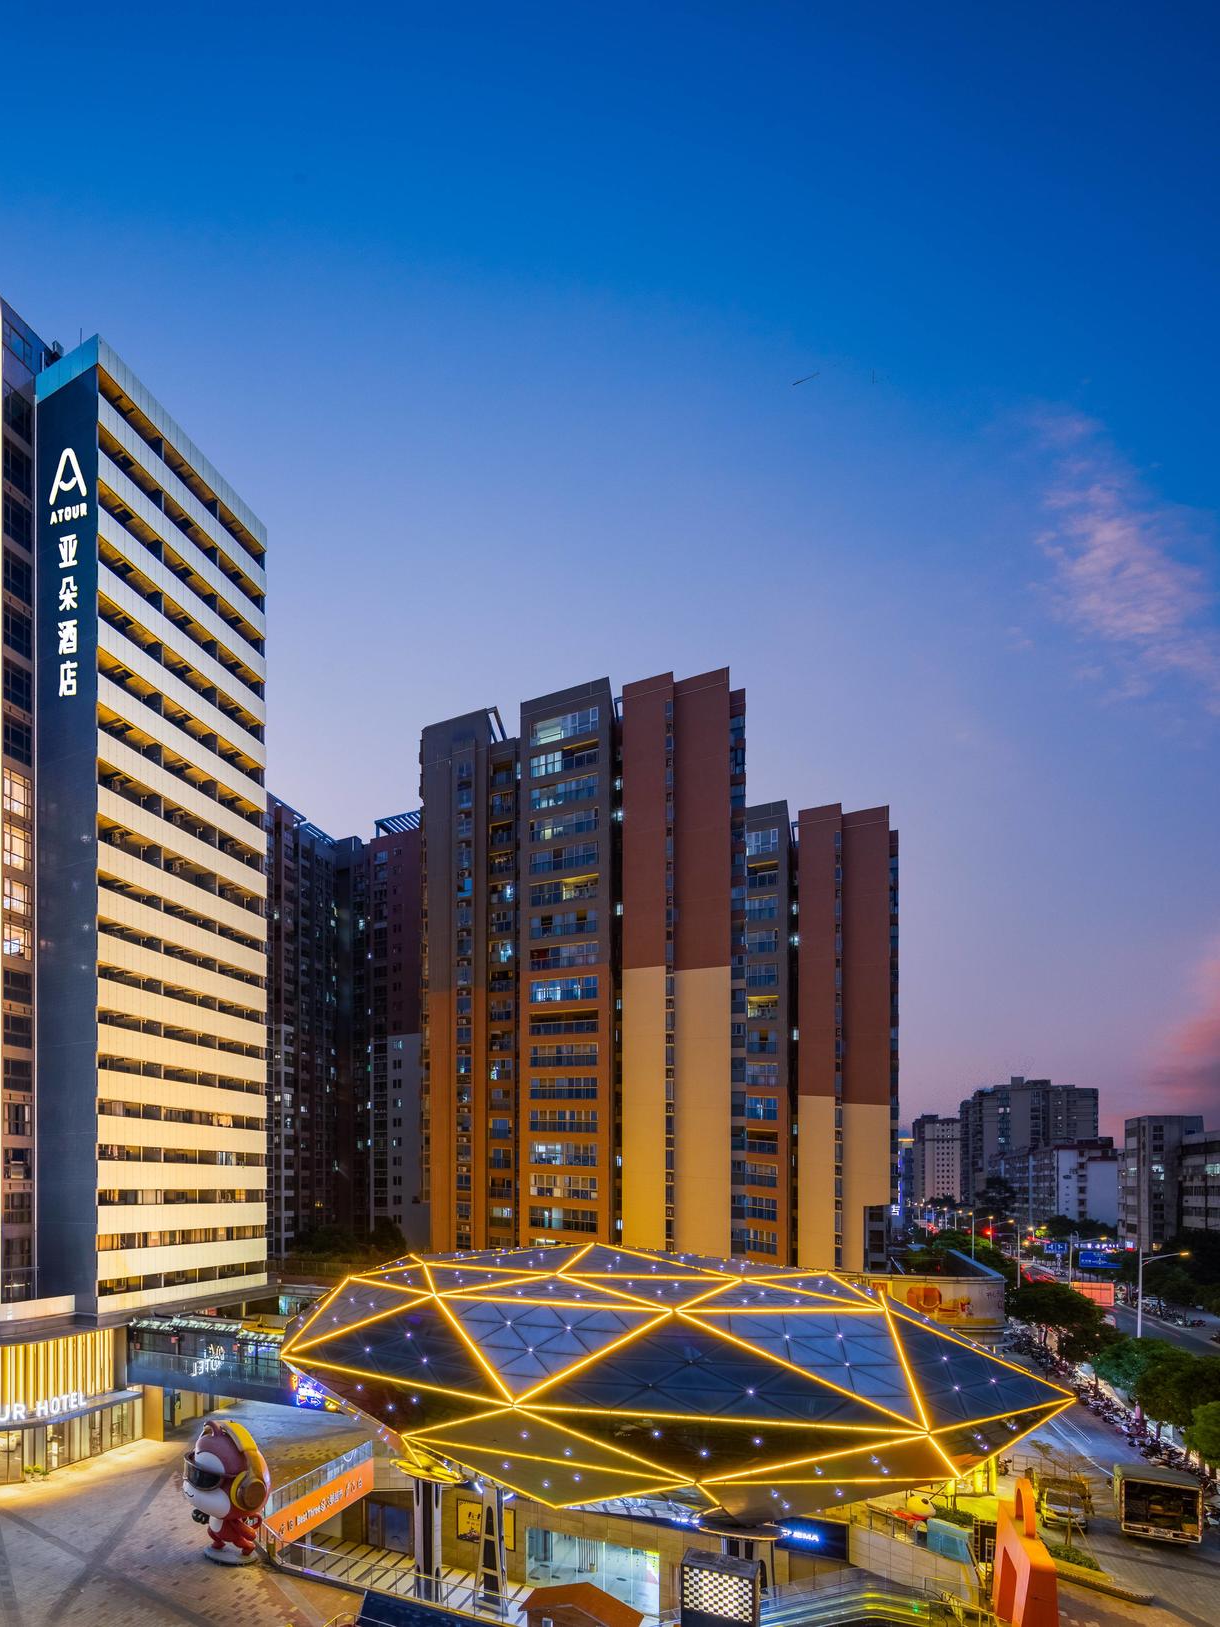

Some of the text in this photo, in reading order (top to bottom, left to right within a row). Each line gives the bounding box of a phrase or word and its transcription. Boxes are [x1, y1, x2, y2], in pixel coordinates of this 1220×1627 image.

[49, 502, 87, 525] ATOUR
[58, 533, 78, 697] 亚朵酒店
[35, 1391, 88, 1417] HOTEL
